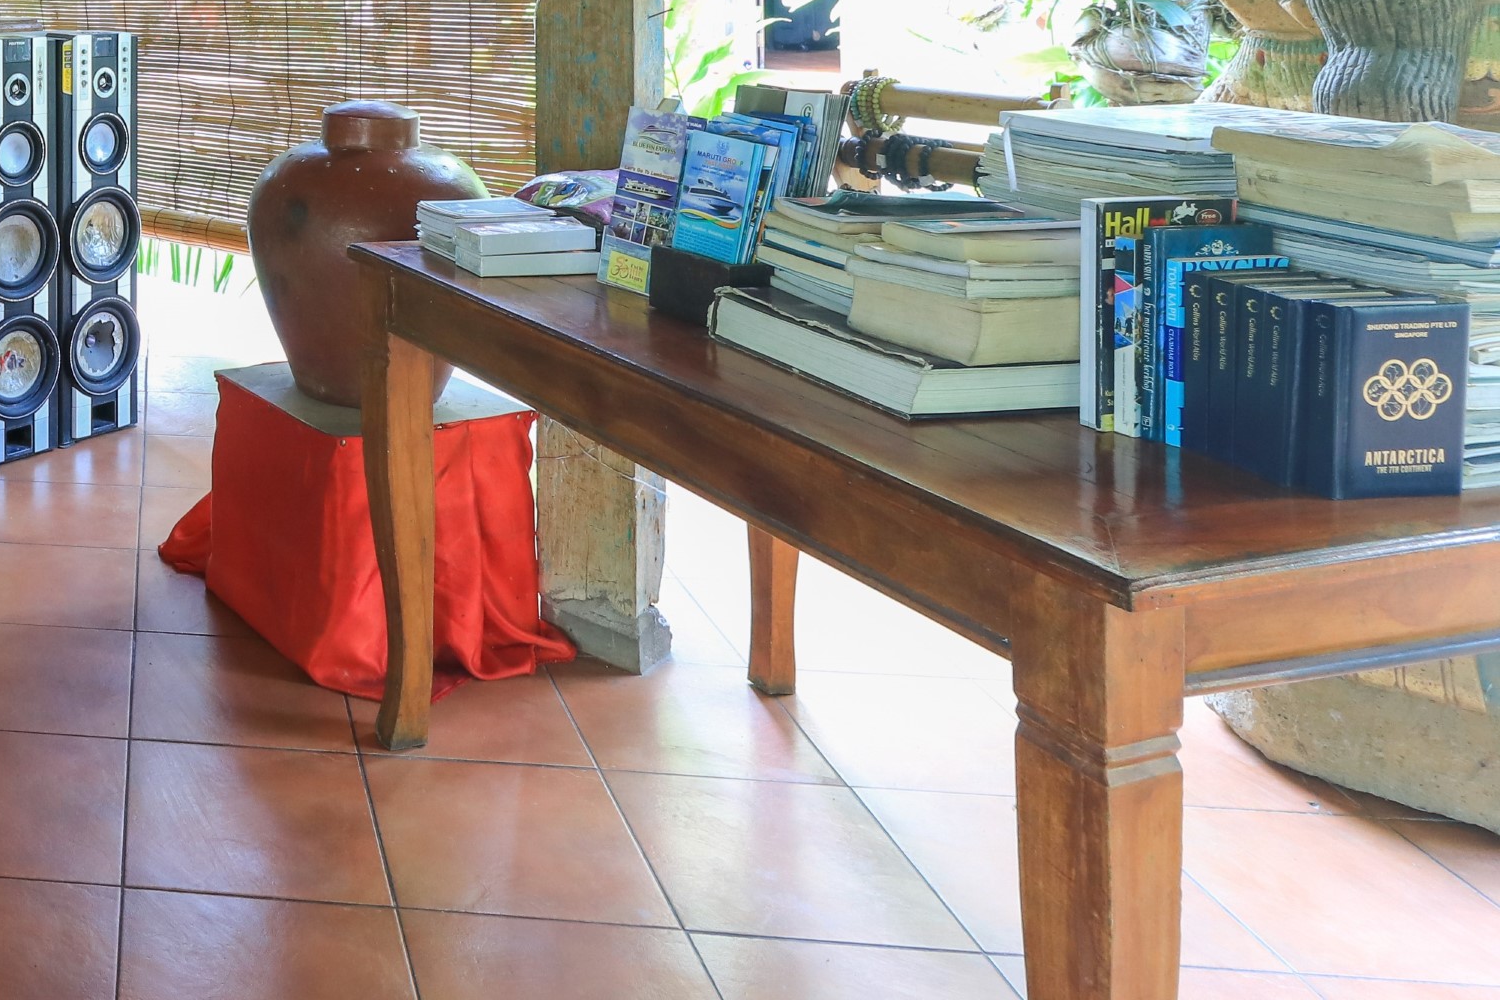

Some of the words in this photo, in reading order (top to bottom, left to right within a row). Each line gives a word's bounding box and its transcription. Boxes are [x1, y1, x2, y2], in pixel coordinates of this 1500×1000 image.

[697, 150, 722, 162] MARUTI
[1400, 322, 1430, 330] TRADING
[1394, 331, 1429, 339] SINGAPORE
[1364, 447, 1446, 467] ANTARCTICA
[1376, 466, 1388, 474] THE
[1388, 465, 1400, 474] 7TH
[1400, 464, 1433, 473] CONTINENT
